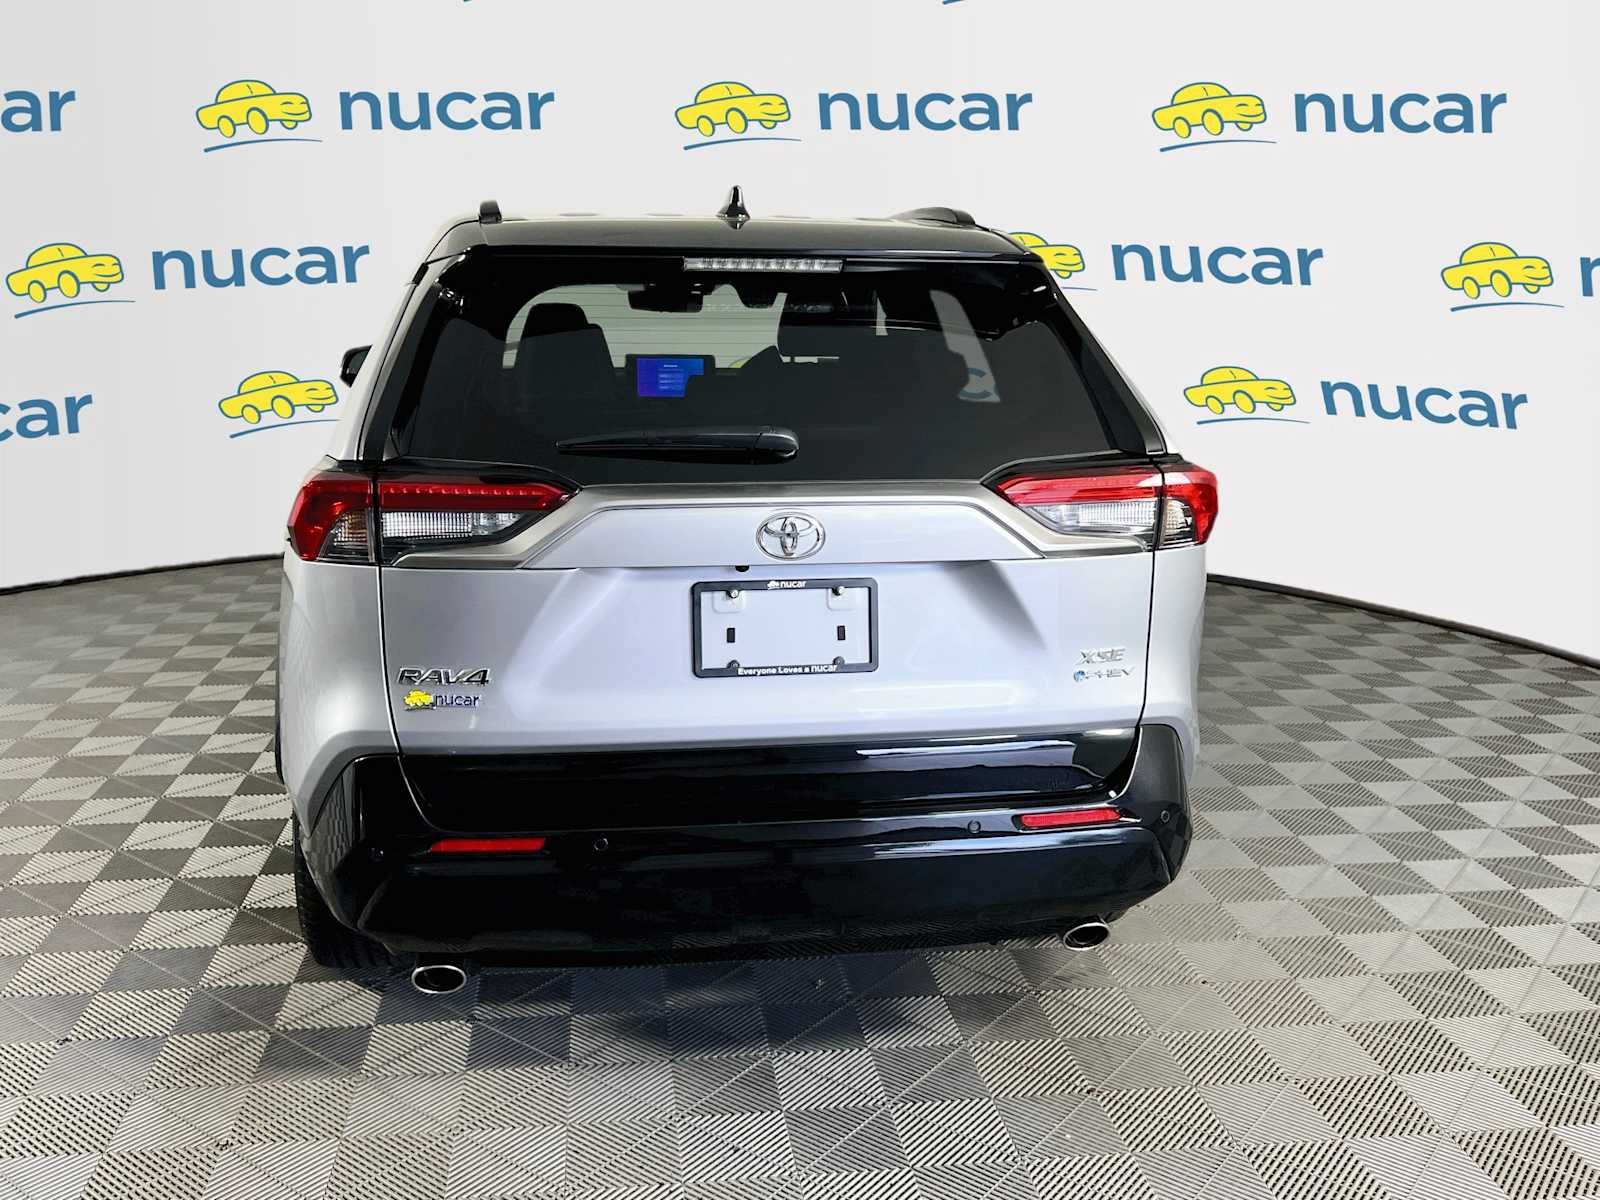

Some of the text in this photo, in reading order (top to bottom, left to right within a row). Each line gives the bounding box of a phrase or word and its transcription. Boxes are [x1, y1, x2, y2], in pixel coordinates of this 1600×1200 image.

[338, 90, 555, 132] nucar
[817, 91, 1033, 132] nucar
[1294, 91, 1507, 134] nucar
[151, 243, 370, 290] nucar
[1110, 243, 1324, 286] nucar
[1320, 379, 1528, 430] nucar
[780, 580, 807, 589] nucar
[398, 668, 490, 685] RAV4
[737, 667, 777, 676] Everyone
[779, 666, 802, 674] Loves
[811, 664, 838, 673] nucar
[435, 694, 480, 707] nucar
